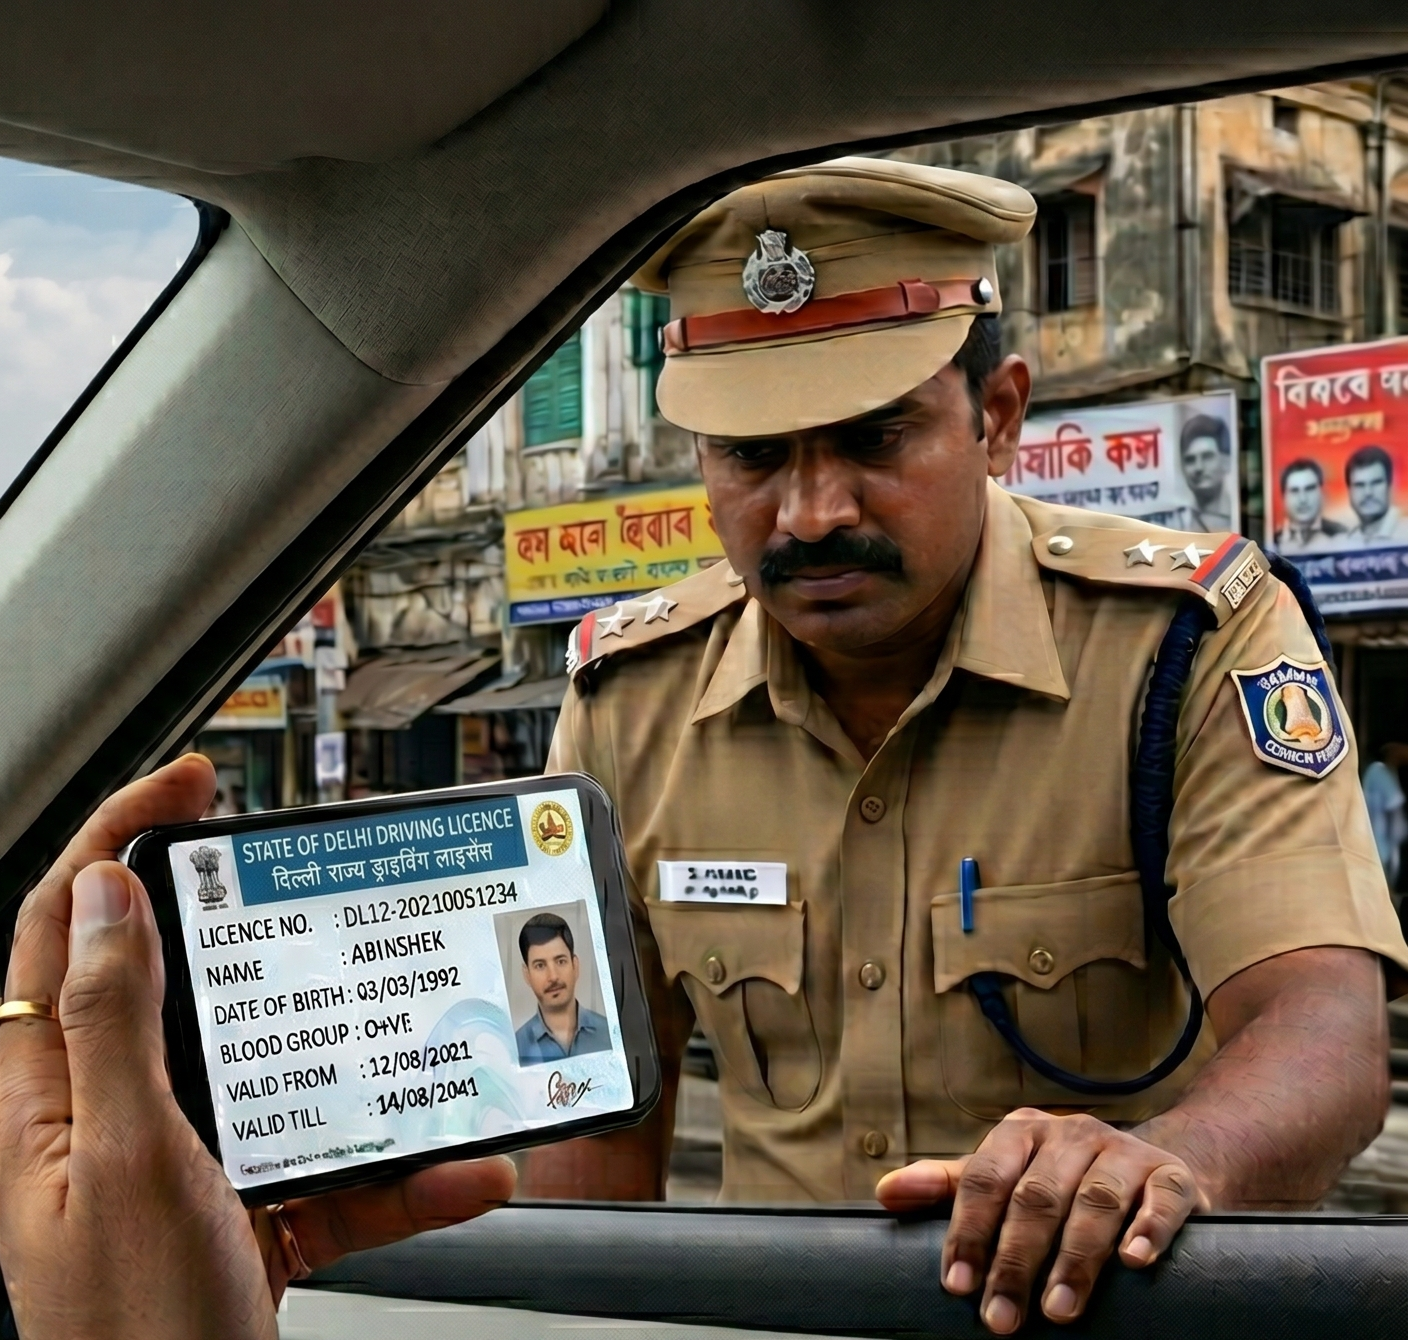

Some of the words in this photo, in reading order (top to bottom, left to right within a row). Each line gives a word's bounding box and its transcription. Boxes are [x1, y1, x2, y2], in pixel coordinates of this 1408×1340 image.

[242, 838, 294, 864] STATE
[297, 834, 319, 855] OF
[324, 827, 372, 852] DELHI
[377, 817, 444, 845] DRIVING
[448, 808, 514, 835] LICENCE
[272, 861, 322, 891] दिल्ली
[327, 860, 366, 883] राज्य
[370, 846, 429, 883] ड्राइविंग
[434, 838, 493, 870] लाइसेंस
[199, 918, 275, 950] LICENCE
[279, 913, 313, 938] NO.
[206, 960, 264, 987] NAME
[351, 930, 446, 965] ABINSHEK
[214, 999, 260, 1025] DATE
[264, 995, 288, 1017] OF
[294, 985, 344, 1013] BIRTH
[220, 1035, 283, 1064] BLOOD
[287, 1023, 349, 1053] GROUP
[227, 1076, 279, 1103] VALID
[282, 1064, 338, 1093] FROM
[370, 1040, 473, 1077] 12/08/2021
[232, 1114, 285, 1141] VALID
[288, 1106, 327, 1130] TILL
[376, 1077, 479, 1115] 14/08/2041
